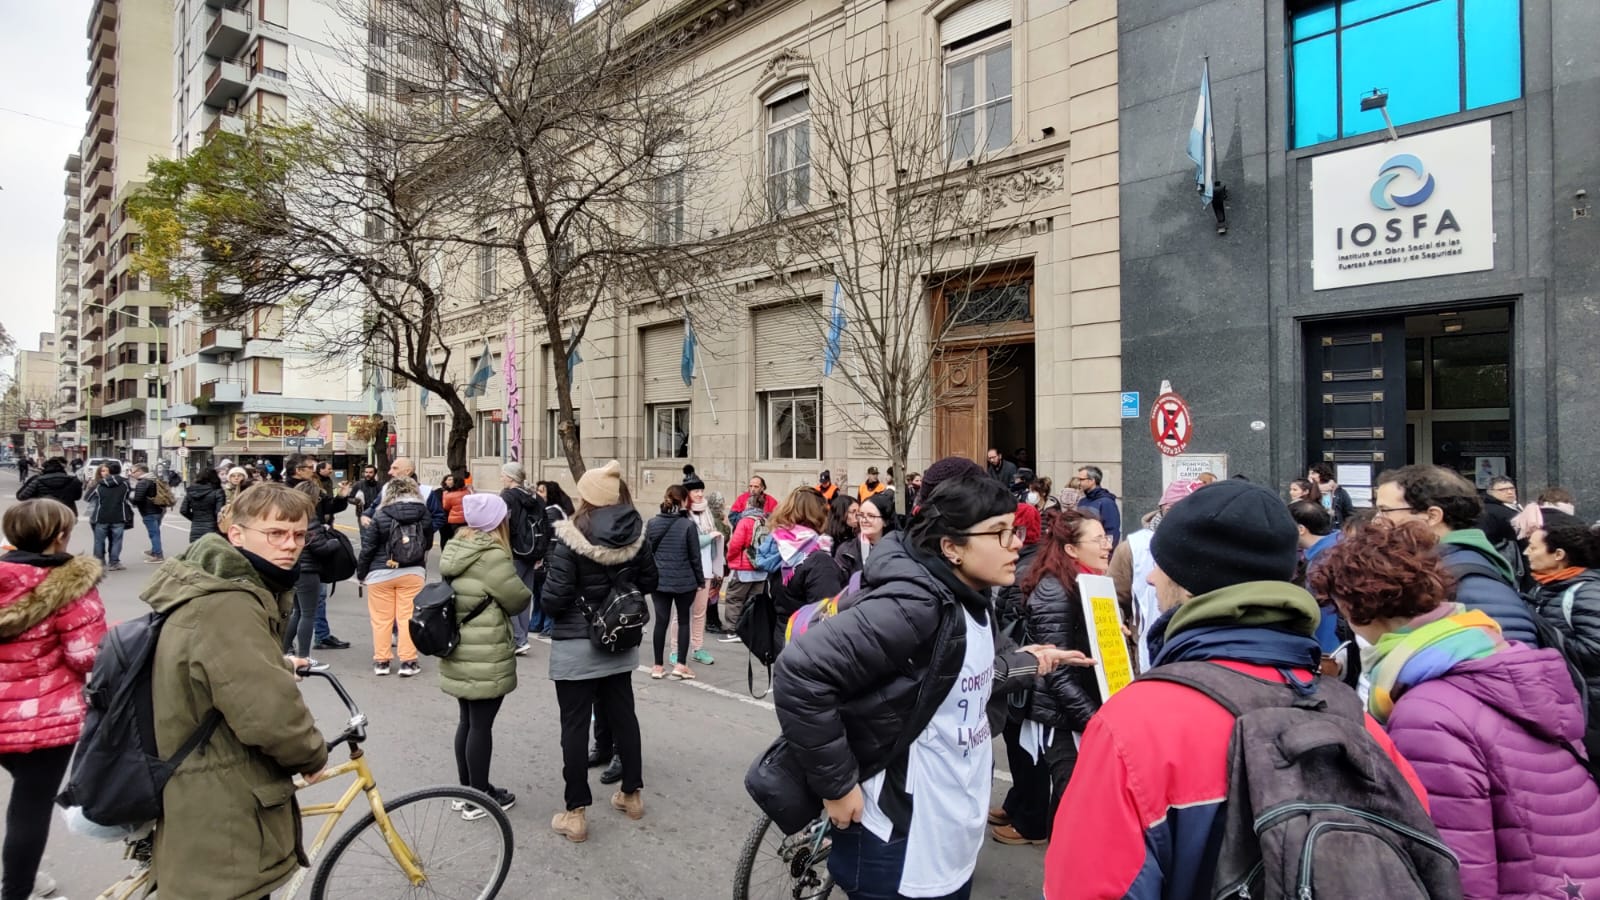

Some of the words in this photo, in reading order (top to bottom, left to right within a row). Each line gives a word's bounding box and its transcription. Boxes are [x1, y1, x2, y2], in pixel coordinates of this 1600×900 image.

[1336, 209, 1461, 250] IOSFA
[1338, 252, 1369, 261] Instituto
[1385, 247, 1405, 255] Obra
[1408, 242, 1433, 251] Social
[1436, 240, 1446, 248] de
[1449, 238, 1460, 246] las
[1338, 262, 1366, 270] Fuerzas
[1368, 257, 1401, 266] Armadas
[1410, 253, 1420, 261] de
[1421, 249, 1462, 260] Seguridad
[958, 699, 968, 722] 9
